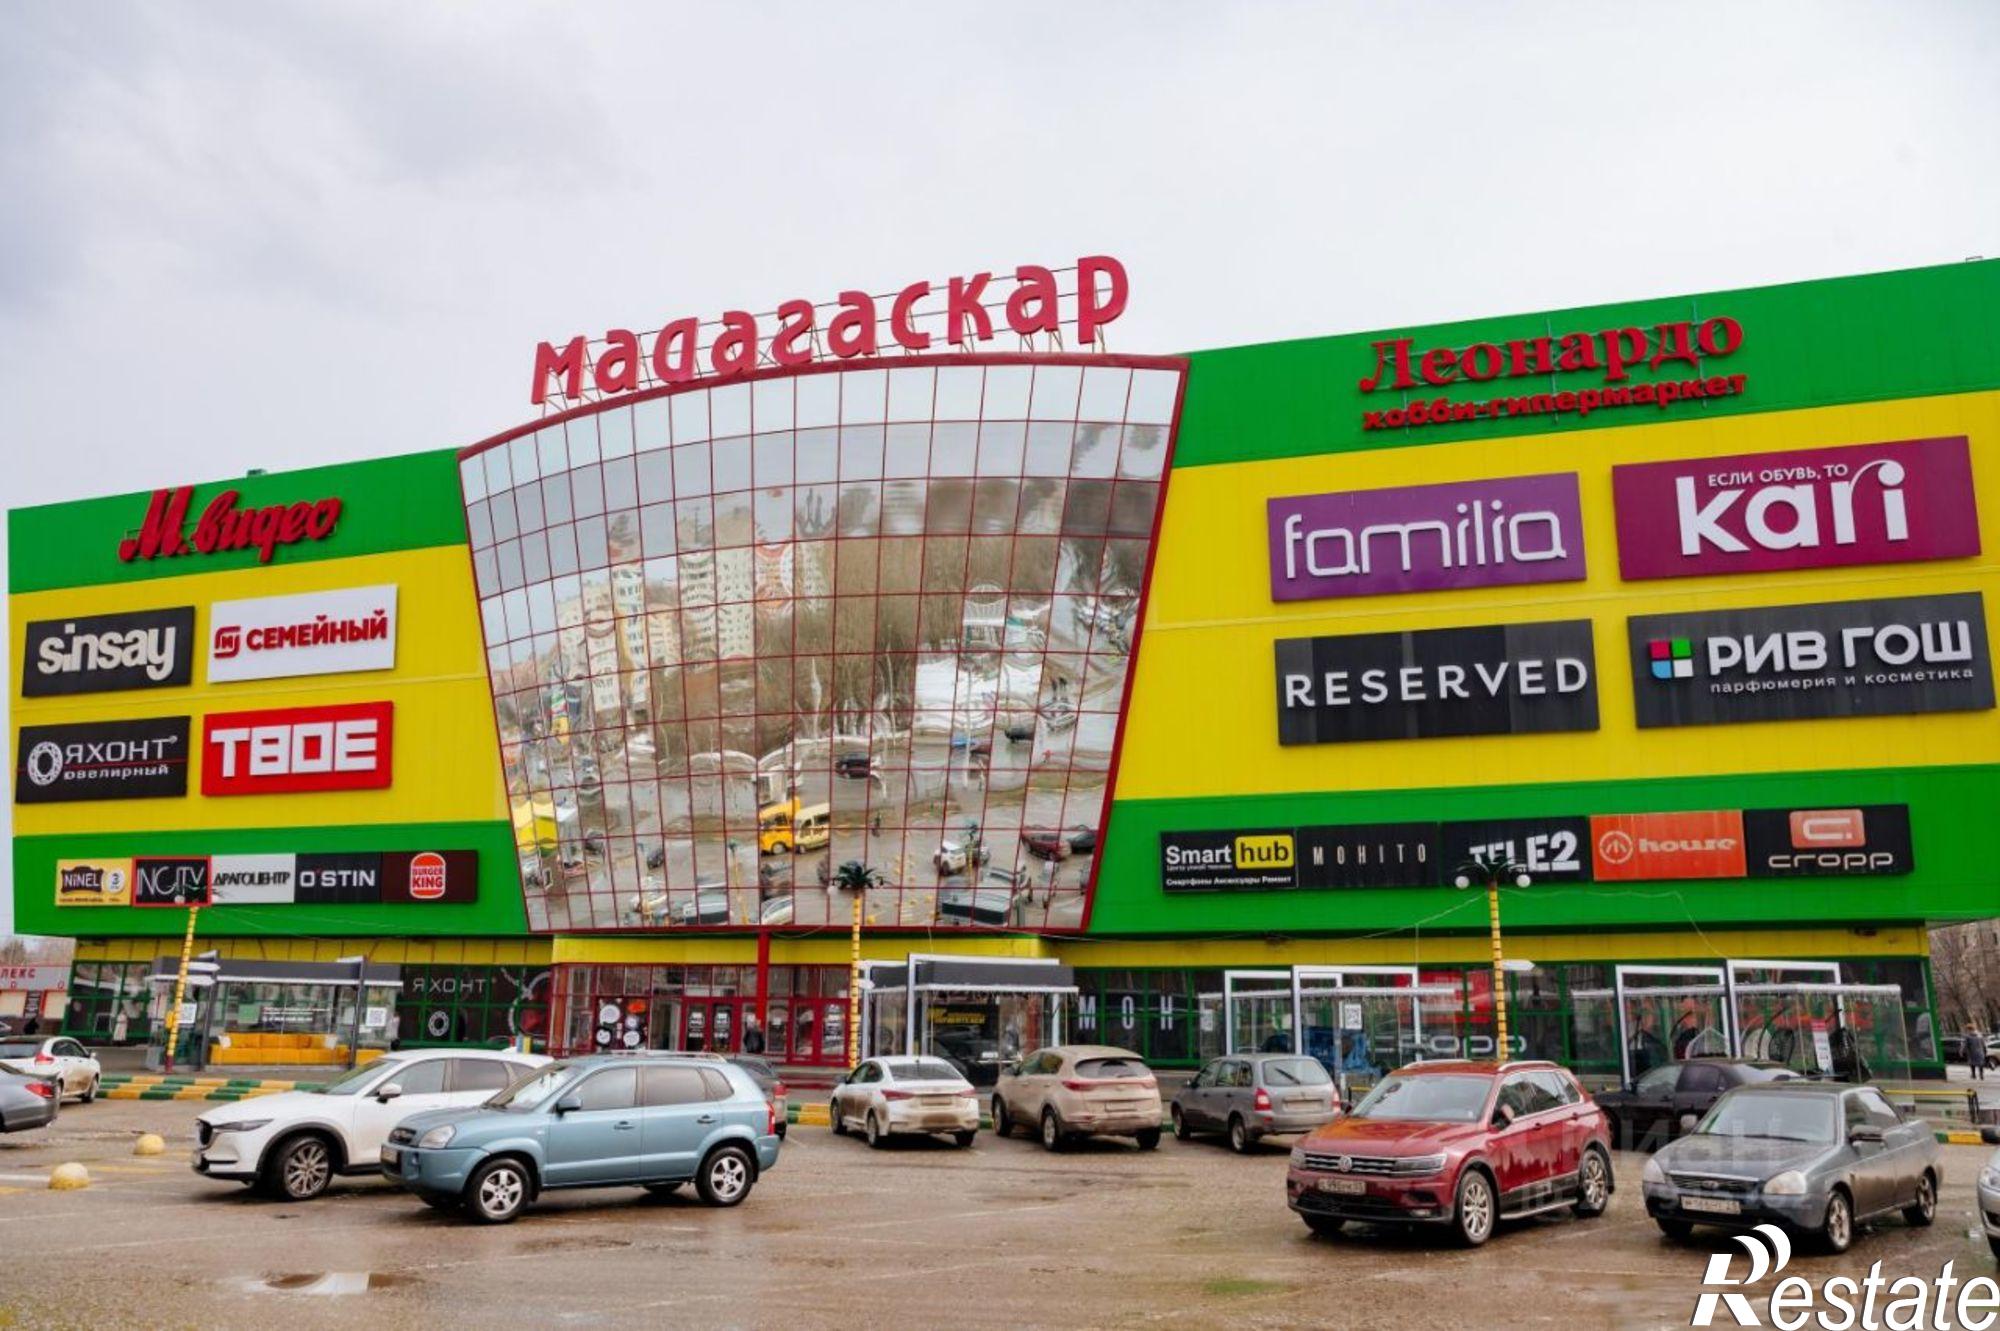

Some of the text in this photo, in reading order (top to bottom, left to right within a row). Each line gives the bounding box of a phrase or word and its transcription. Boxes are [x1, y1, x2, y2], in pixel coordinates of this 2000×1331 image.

[1359, 316, 1743, 393] Леонардо
[1362, 375, 1748, 431] хобби-гипермаркет
[1708, 463, 1848, 488] ЕСЛИ ОБУВЬ, ТО
[118, 485, 343, 563] М.видео
[1675, 459, 1909, 556] kari
[1284, 500, 1567, 579] familia
[246, 609, 388, 651] СЕМЕЙНЫЙ
[1707, 620, 1973, 676] РИВ ГОШ
[37, 623, 176, 681] sinsay
[1284, 657, 1588, 709] RESERVED
[1710, 668, 1974, 694] парфюмерия и косметика
[65, 736, 178, 764] ЯХОНТ
[210, 718, 378, 778] ТВОЕ
[63, 764, 169, 781] ювелирный
[1166, 841, 1289, 864] Smart hub
[1313, 844, 1426, 865] MOHITO
[1469, 830, 1580, 872] TELE2
[1768, 852, 1894, 870] cropp
[412, 876, 443, 888] KING
[412, 978, 487, 992] ЯХОНТ
